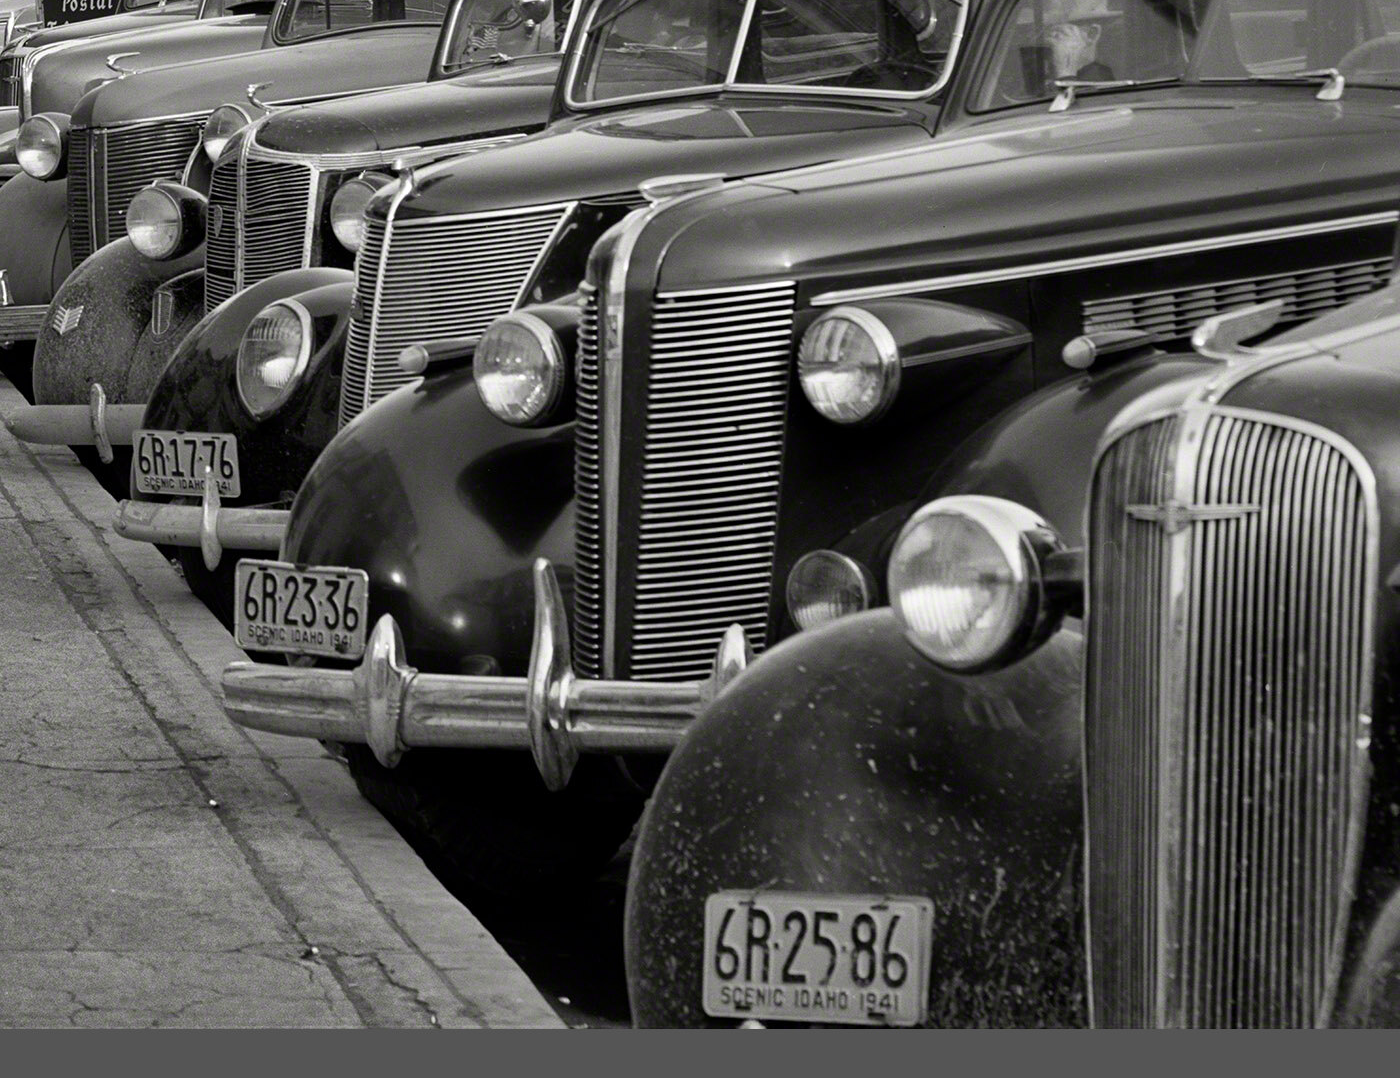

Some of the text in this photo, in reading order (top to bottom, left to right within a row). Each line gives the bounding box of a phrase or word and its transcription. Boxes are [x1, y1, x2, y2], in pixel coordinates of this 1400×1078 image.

[143, 476, 175, 489] SCENIC
[248, 624, 353, 648] SCENIC IDAHO 1941
[720, 986, 899, 1013] SCENIC IDAHO 1941
